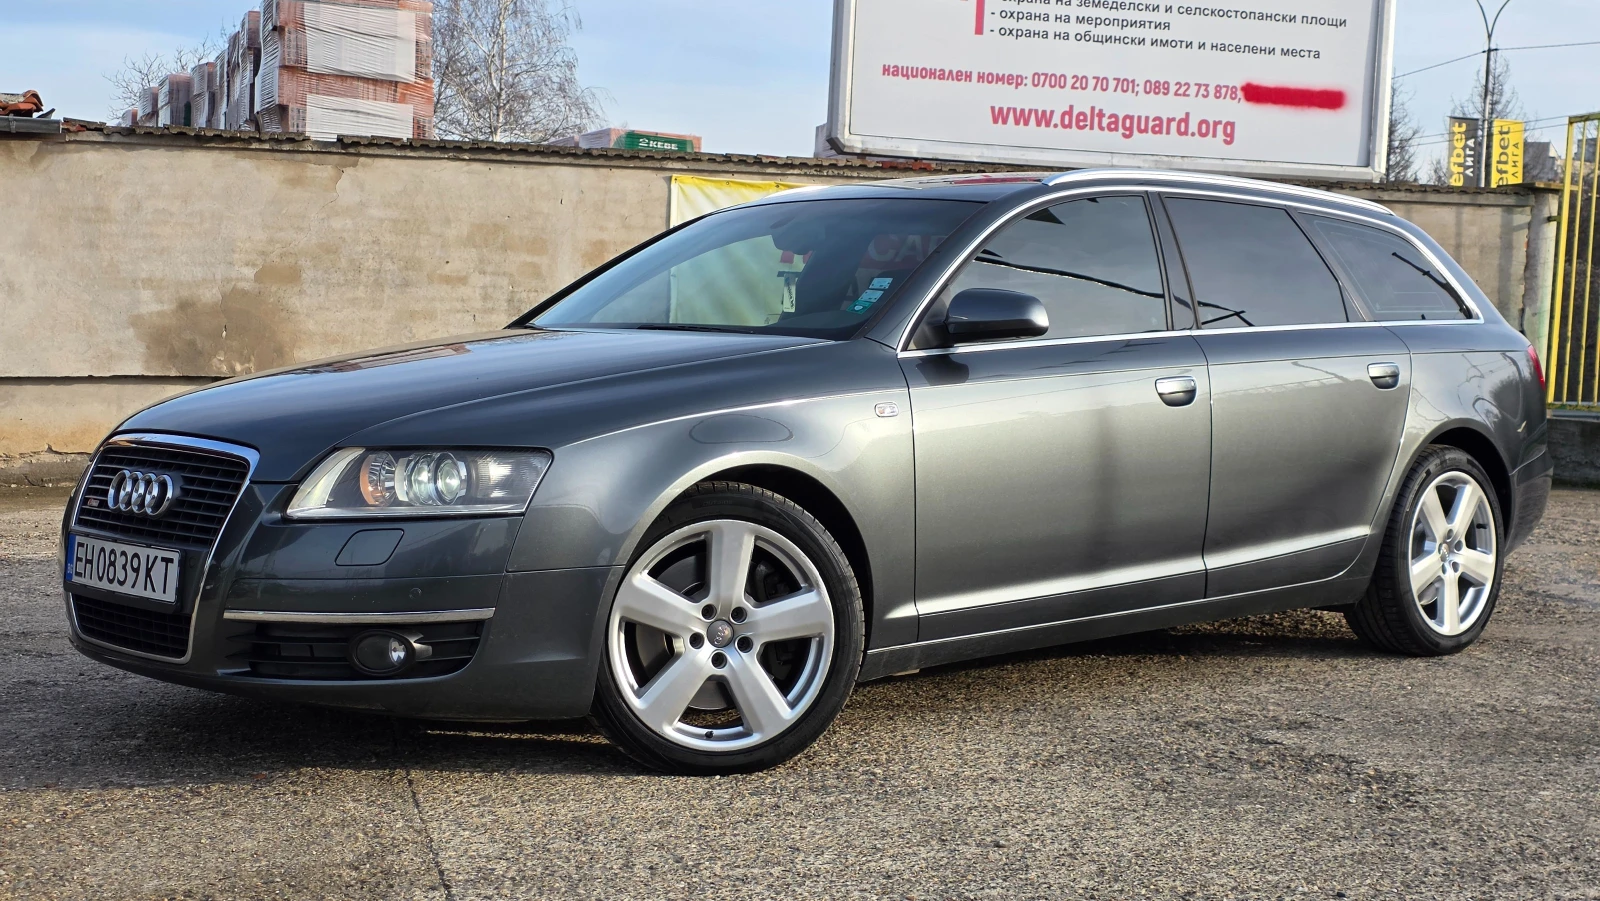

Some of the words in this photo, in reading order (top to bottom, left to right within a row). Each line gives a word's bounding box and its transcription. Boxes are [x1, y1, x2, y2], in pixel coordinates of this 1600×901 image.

[999, 9, 1050, 23] охрана
[1055, 14, 1071, 24] на
[1075, 15, 1171, 31] мероприятия
[1076, 0, 1160, 12] земеделски
[1165, 4, 1173, 14] и
[1177, 5, 1297, 23] селскостопански
[1301, 14, 1347, 28] площи
[998, 26, 1049, 40] охрана
[1053, 30, 1070, 41] на
[1074, 31, 1146, 46] общински
[1150, 37, 1193, 50] имоти
[1198, 41, 1206, 50] и
[1210, 42, 1276, 56] населени
[1280, 47, 1321, 59] места
[882, 64, 973, 82] национален
[977, 71, 1028, 89] номер:
[1032, 72, 1067, 89] 0700
[1070, 74, 1089, 91] 20
[1092, 76, 1109, 92] 70
[1113, 77, 1140, 97] 701;
[1144, 79, 1170, 96] 089
[1173, 81, 1191, 98] 22
[1194, 82, 1210, 99] 73
[1214, 84, 1242, 104] 878,
[990, 104, 1236, 146] www.deltaguard.org
[1450, 122, 1467, 187] efbet
[1465, 138, 1475, 177] ЛИГА
[1496, 125, 1511, 186] efbet
[1511, 141, 1520, 179] ЛИГА
[74, 541, 174, 594] EH0839KT
